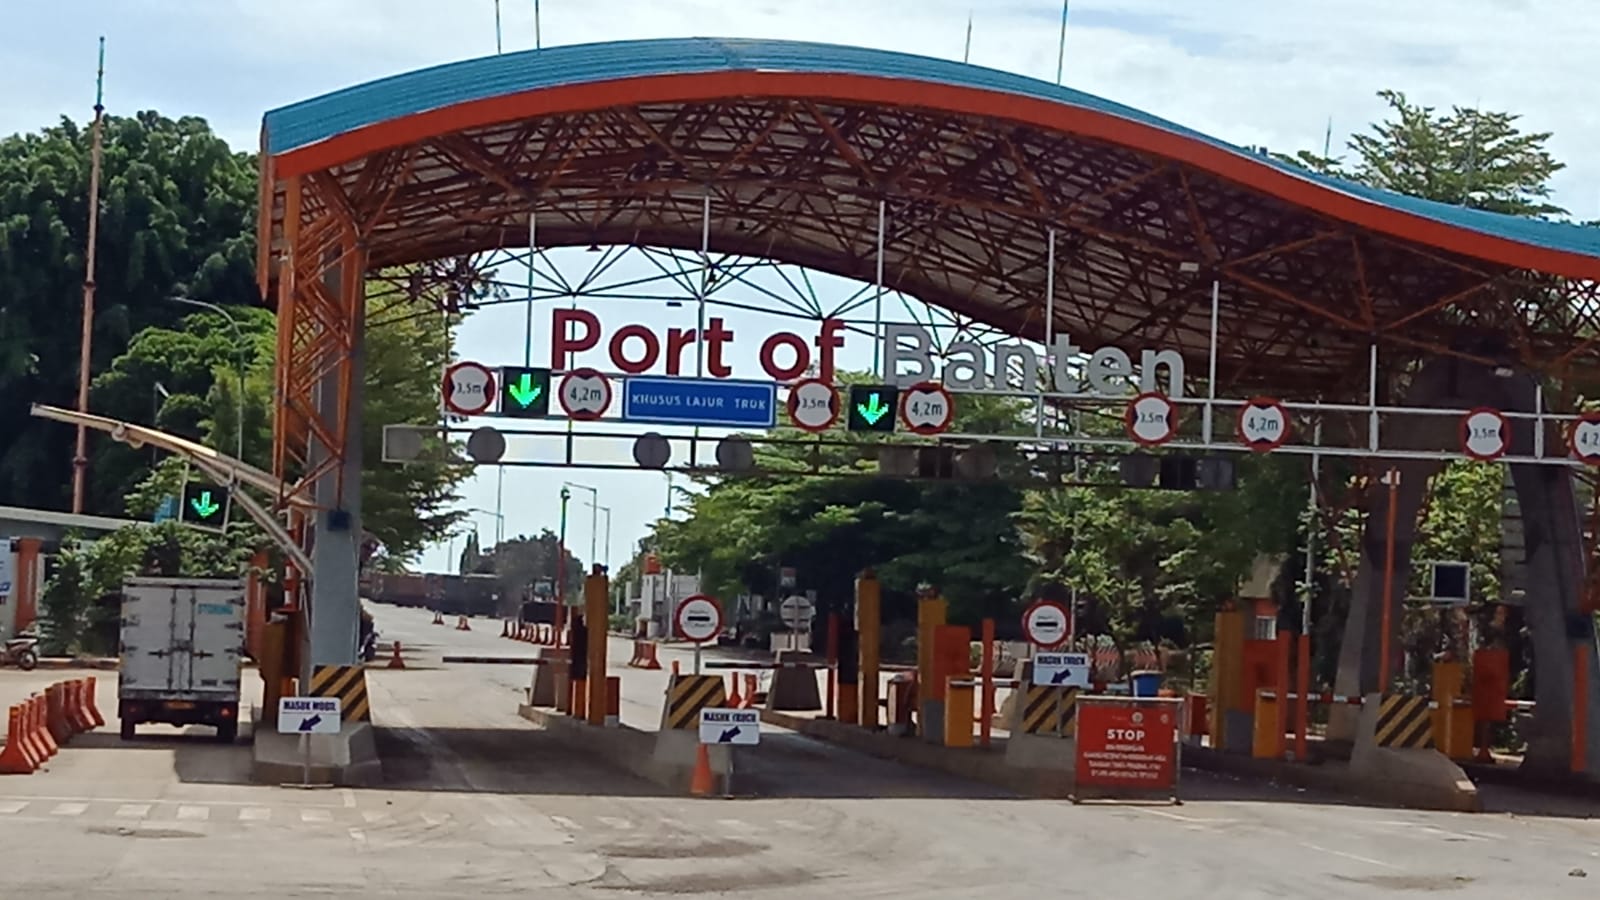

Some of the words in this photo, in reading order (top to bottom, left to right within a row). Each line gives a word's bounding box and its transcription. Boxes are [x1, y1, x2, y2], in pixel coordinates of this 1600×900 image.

[550, 308, 734, 378] Port
[759, 318, 846, 384] of
[884, 323, 1186, 399] Banten
[570, 386, 602, 403] 4,2m
[632, 393, 682, 407] KHUSUS
[686, 396, 724, 408] LAJUR
[734, 398, 767, 410] TRUK
[911, 401, 943, 417] 4,2m
[1247, 416, 1279, 433] 4,2m
[283, 700, 311, 710] MASUK
[1106, 728, 1146, 741] STOP
